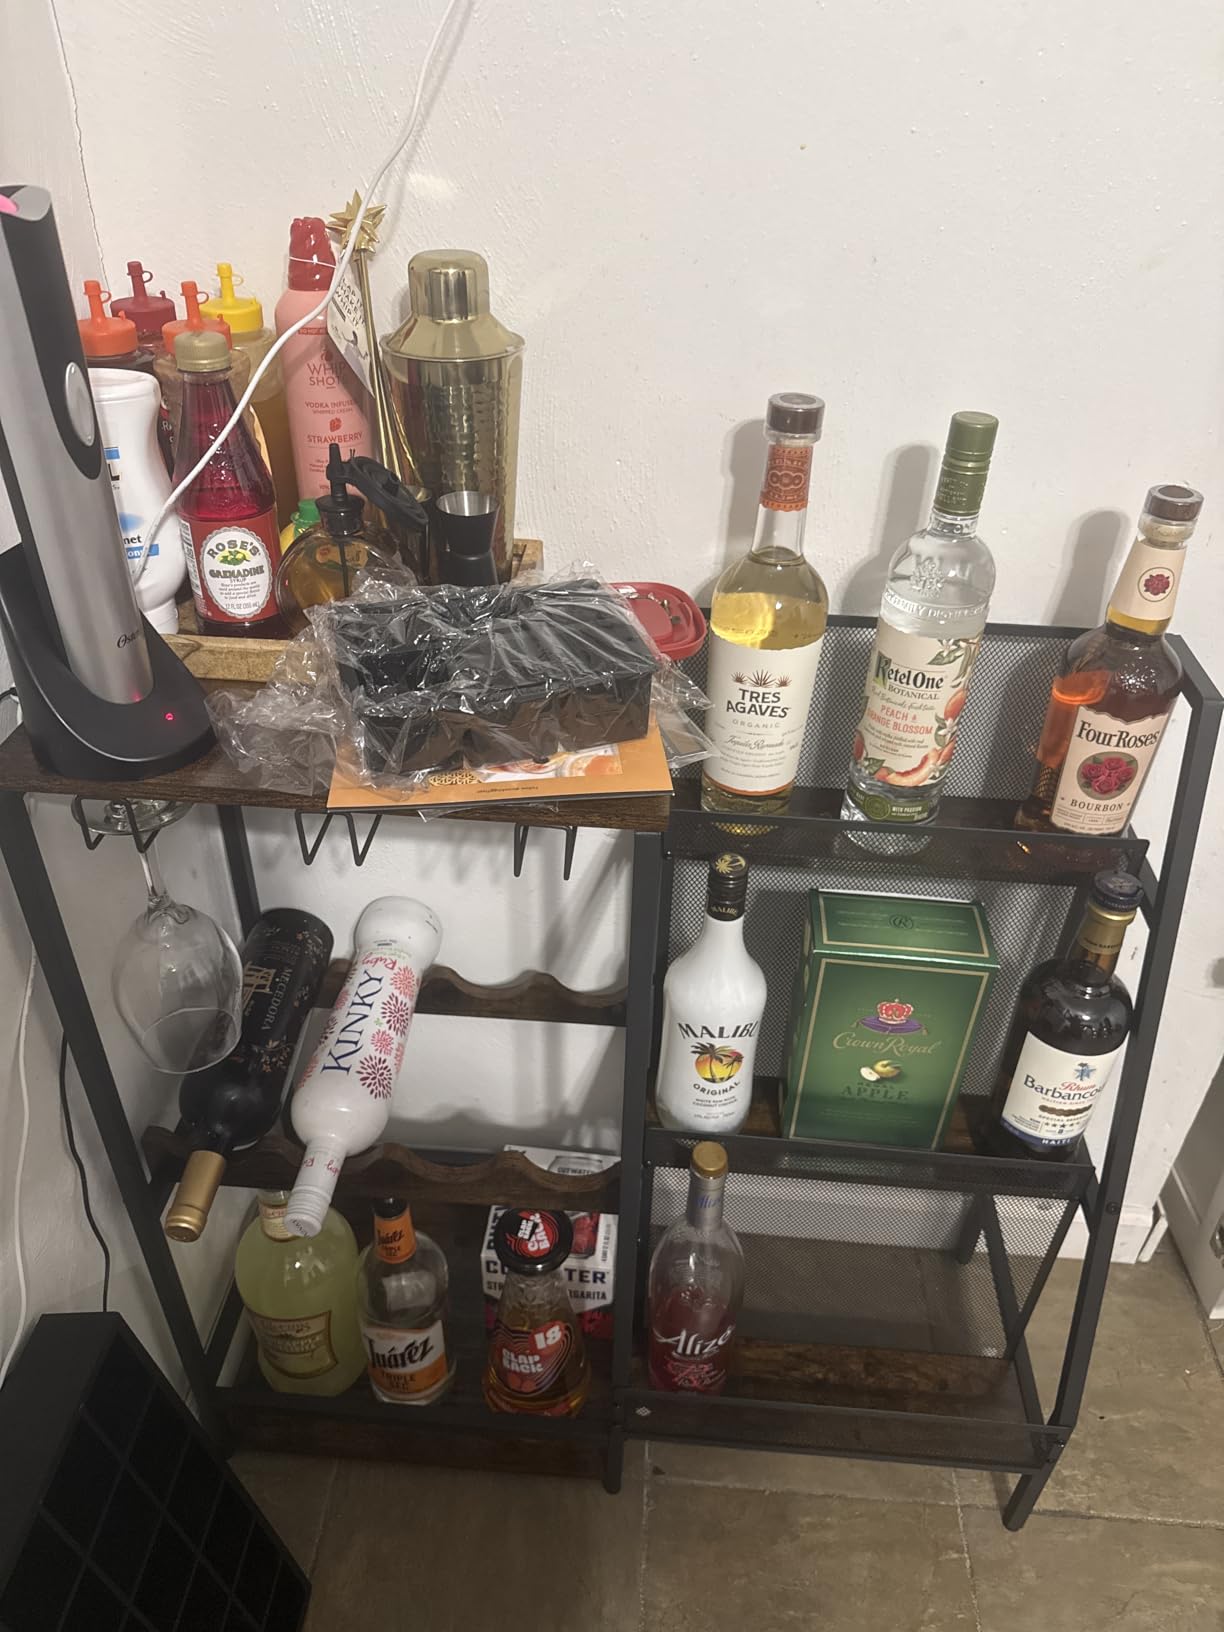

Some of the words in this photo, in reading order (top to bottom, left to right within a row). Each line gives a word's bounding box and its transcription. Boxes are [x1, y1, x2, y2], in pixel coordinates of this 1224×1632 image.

[305, 401, 329, 409] VODKA
[307, 431, 363, 444] STRAWBERRY
[207, 539, 260, 559] ROSE'S
[208, 565, 265, 579] GRENADINE
[912, 670, 944, 690] One
[738, 687, 781, 704] TRES
[888, 684, 940, 700] BOTANICAL
[726, 700, 789, 718] AGAVES
[880, 704, 909, 721] PEACH
[732, 718, 781, 729] ORGANIC
[892, 721, 934, 736] BLOSSOM
[1076, 719, 1116, 747] Four
[1113, 730, 1160, 749] Roses
[1070, 798, 1124, 813] BOURBON
[261, 966, 294, 1031] MECEDORA
[321, 969, 384, 1075] KINKY
[832, 1031, 885, 1050] Crown
[879, 1037, 943, 1057] Royal
[692, 1080, 741, 1096] ORIGINAL
[840, 1085, 910, 1101] APPLE
[1059, 1081, 1097, 1092] Rhum
[534, 1325, 562, 1350] 18
[502, 1348, 541, 1364] CLAP
[502, 1357, 544, 1374] BACK
